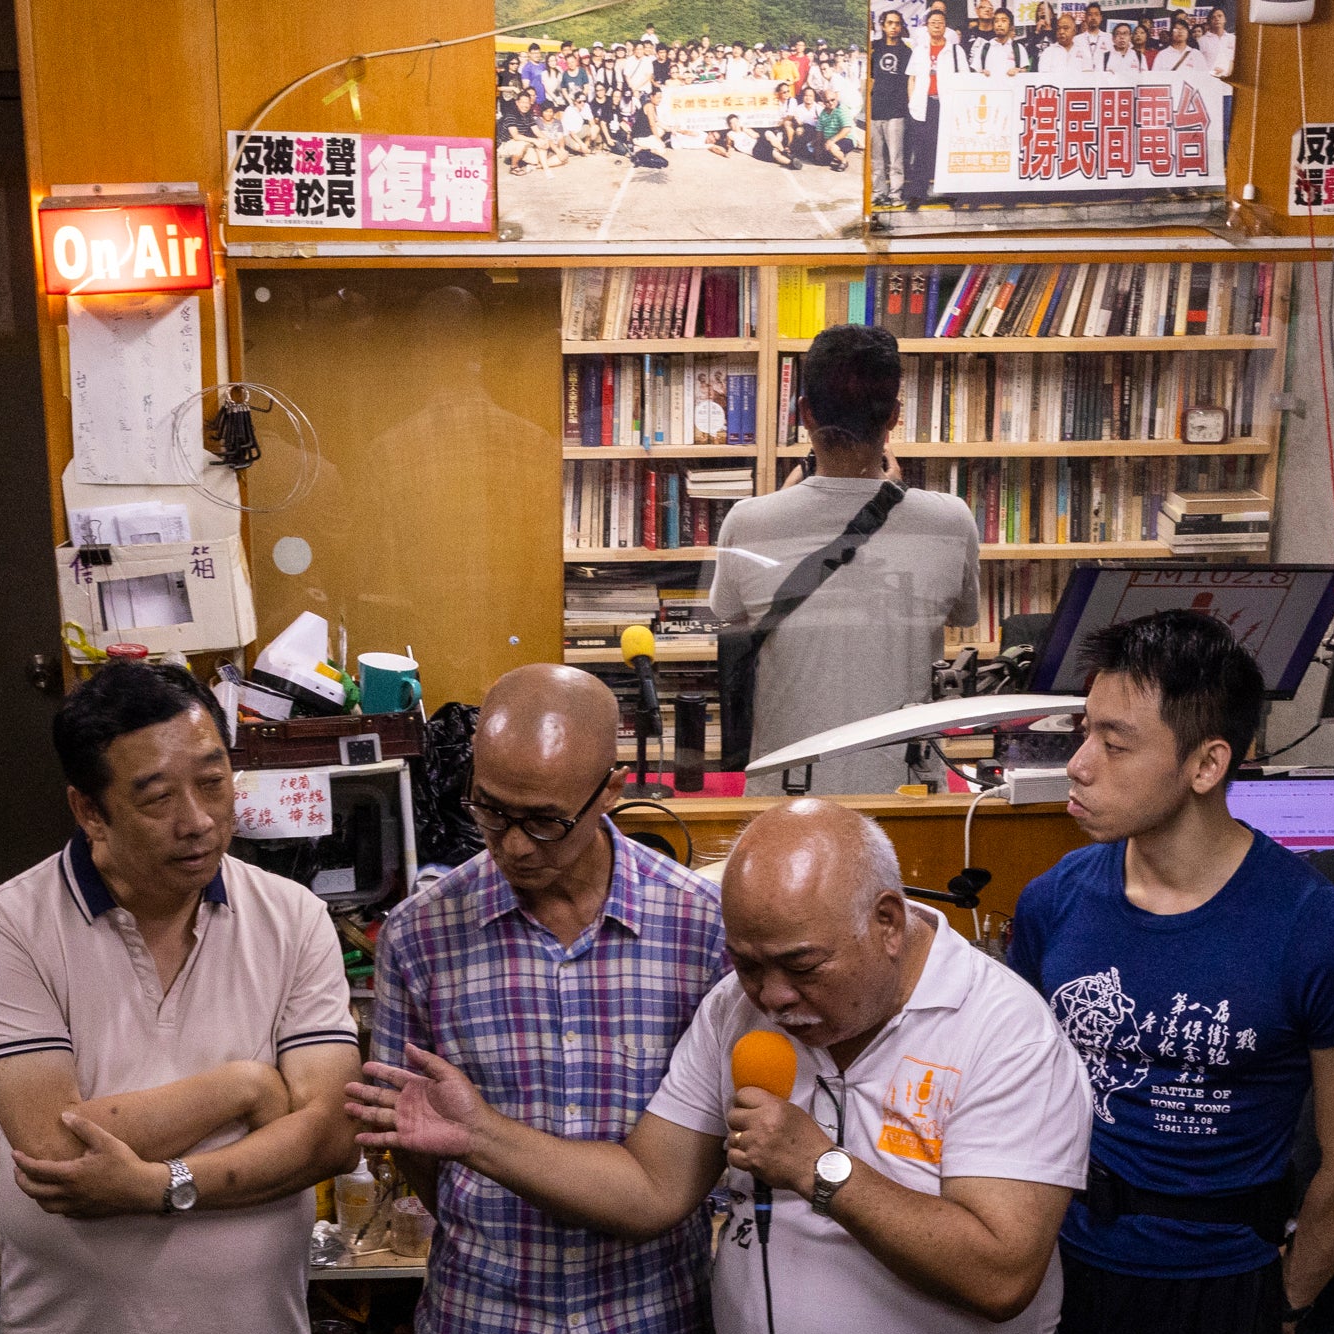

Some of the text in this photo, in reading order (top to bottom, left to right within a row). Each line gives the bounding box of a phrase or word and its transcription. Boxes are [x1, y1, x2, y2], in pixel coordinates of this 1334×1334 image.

[1019, 81, 1211, 180] 撐民間電台
[236, 135, 356, 177] 反被滅聲
[454, 167, 479, 179] dbc
[368, 144, 488, 224] 復播
[234, 178, 356, 218] 還聲於民
[53, 226, 203, 279] On Air
[1130, 569, 1289, 586] FM102.8
[1151, 1085, 1232, 1100] BATTLE OF
[1150, 1099, 1231, 1114] HONG KONG
[1154, 1113, 1213, 1125] 1941.12.08
[1153, 1124, 1217, 1135] -1941.12.26
